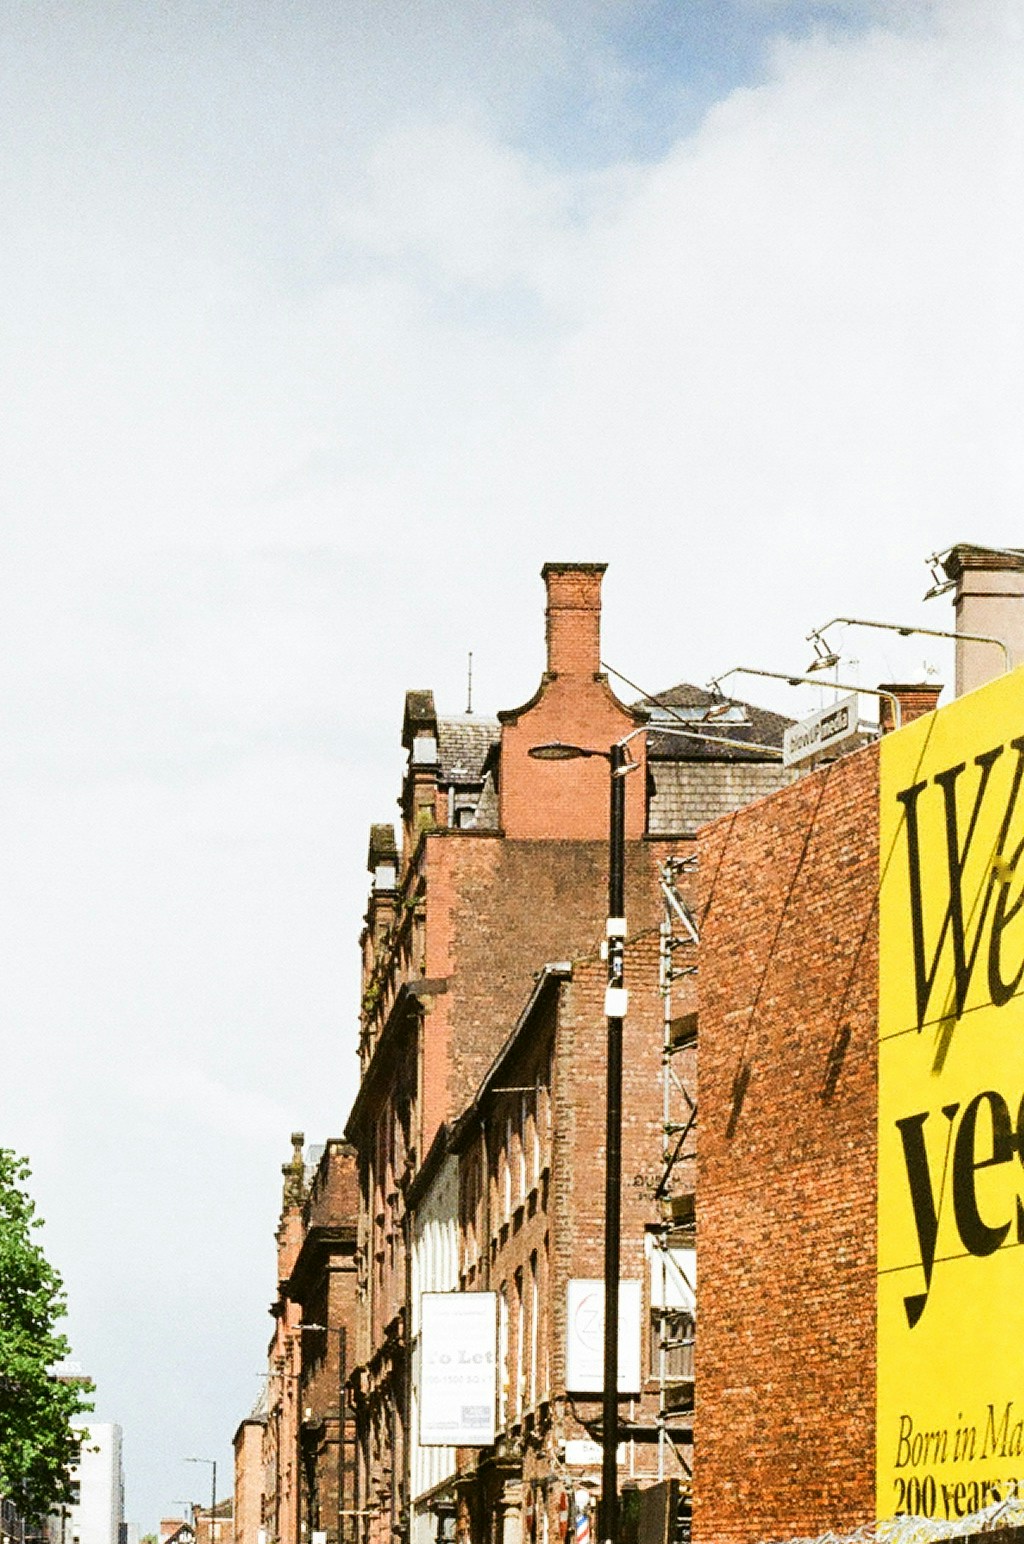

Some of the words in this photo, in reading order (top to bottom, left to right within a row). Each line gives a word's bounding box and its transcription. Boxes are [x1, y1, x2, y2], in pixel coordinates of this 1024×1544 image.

[895, 1090, 1024, 1330] ye
[894, 1414, 948, 1468] Born
[953, 1411, 976, 1463] in
[894, 1474, 937, 1518] 200
